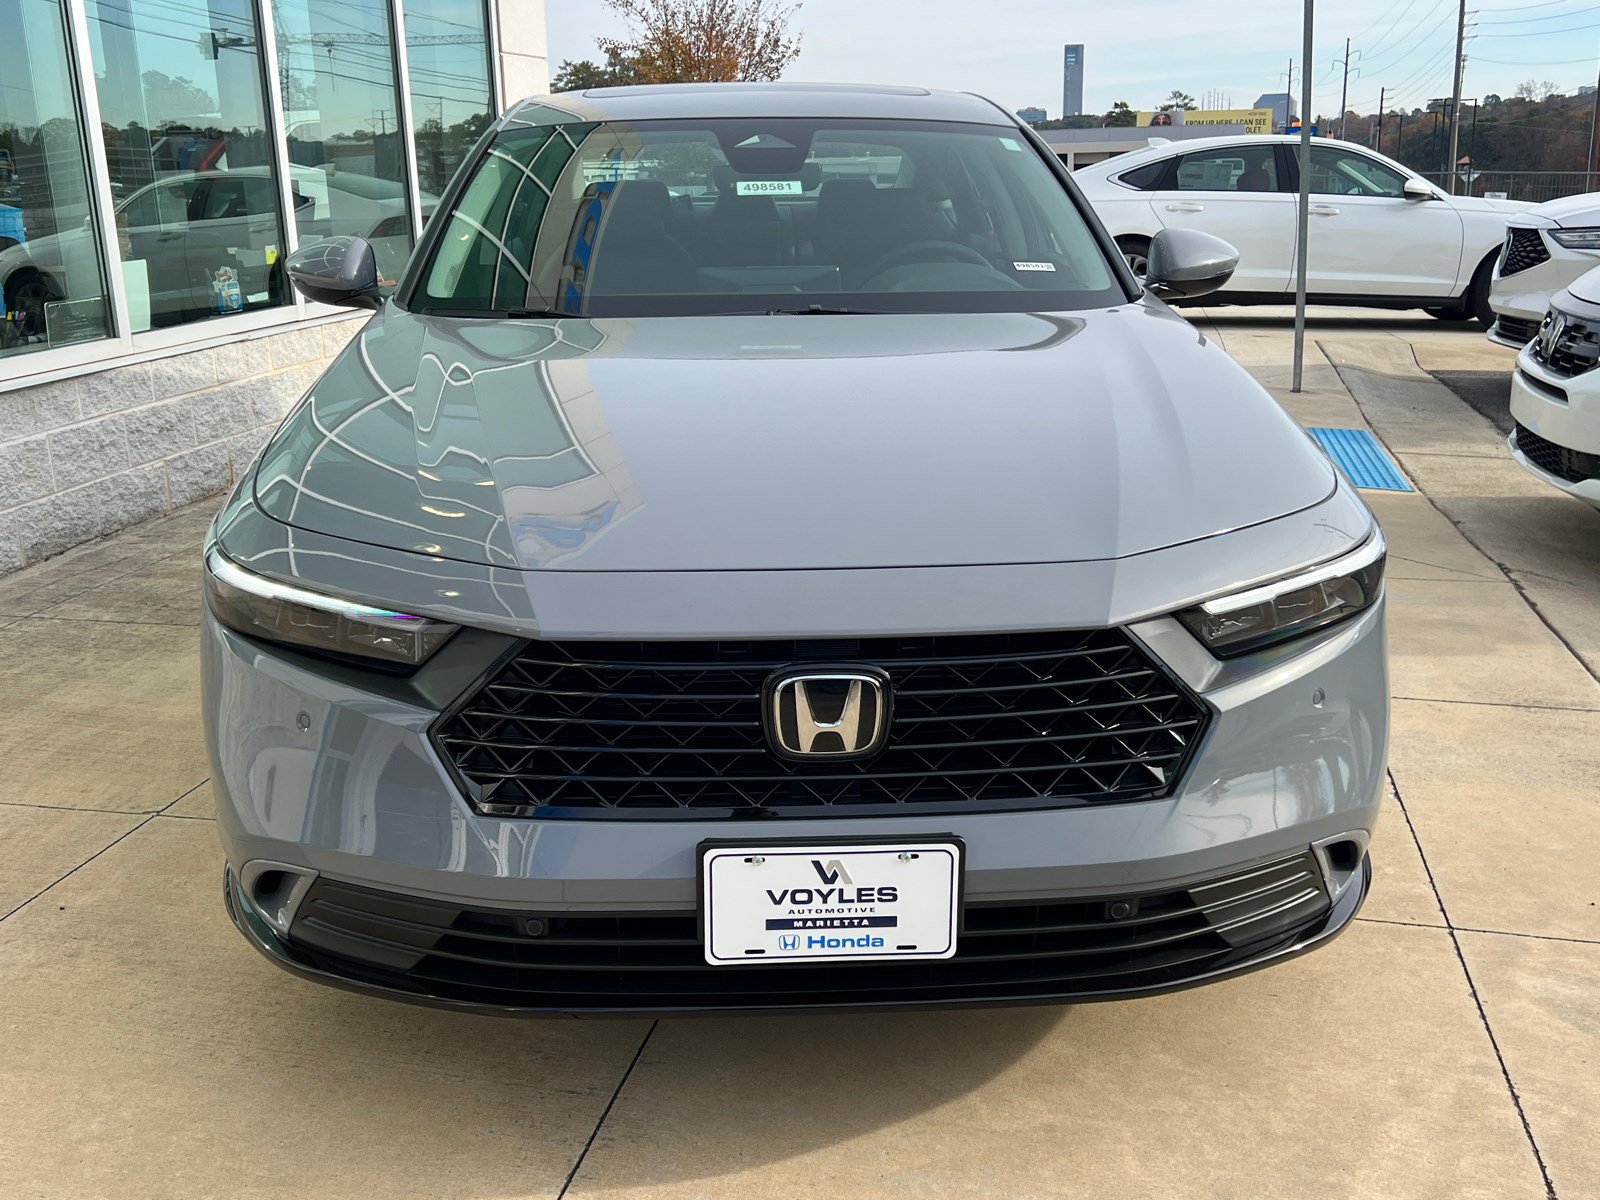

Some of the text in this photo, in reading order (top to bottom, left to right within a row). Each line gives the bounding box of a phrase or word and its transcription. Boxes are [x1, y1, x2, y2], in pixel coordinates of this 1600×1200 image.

[1255, 118, 1267, 126] SEE
[743, 182, 792, 192] 498581
[766, 887, 898, 905] VOYLES
[788, 907, 876, 915] AUTOMOTIVE
[793, 919, 870, 928] MARIETTA
[807, 934, 885, 949] Honda
